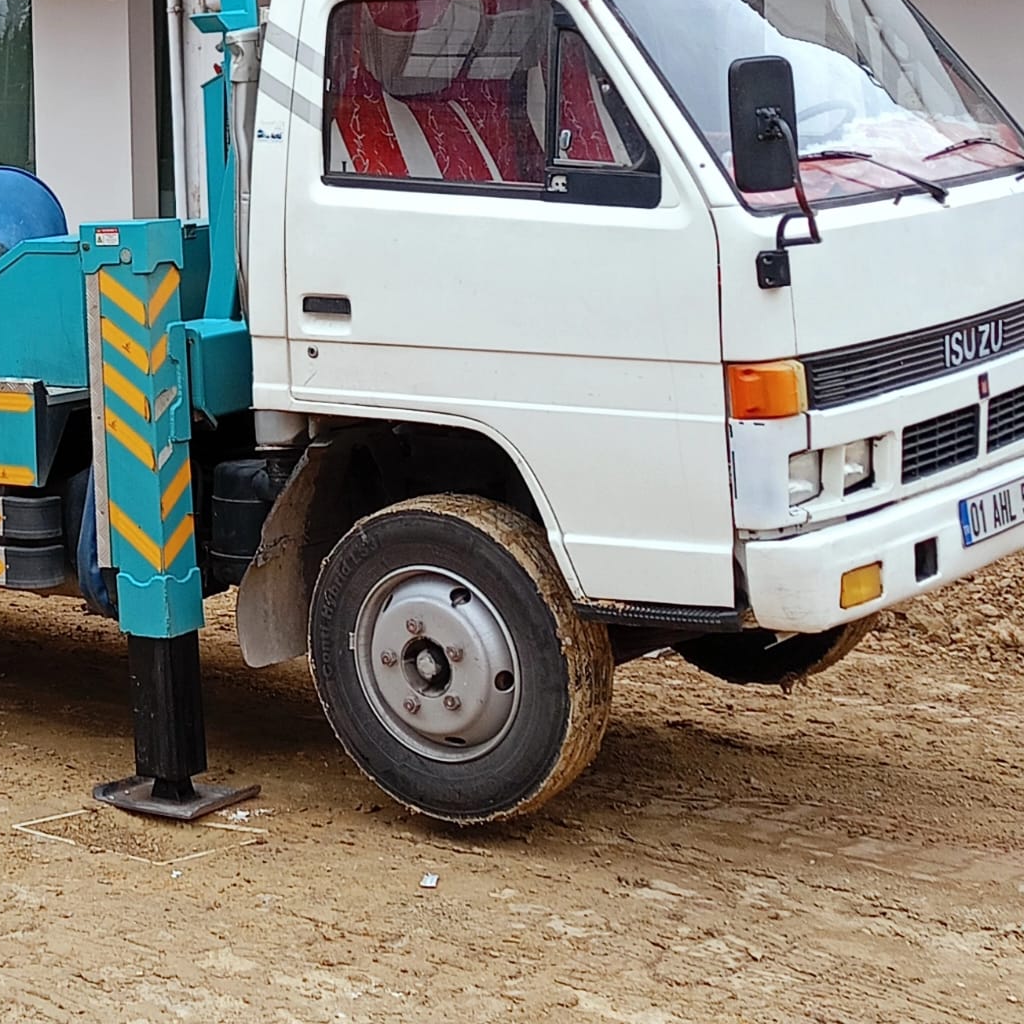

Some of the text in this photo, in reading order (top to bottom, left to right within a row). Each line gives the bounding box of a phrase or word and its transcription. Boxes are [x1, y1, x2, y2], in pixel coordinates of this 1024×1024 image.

[943, 319, 1004, 368] ISUZU
[970, 499, 987, 537] 01
[993, 489, 1017, 529] AHL
